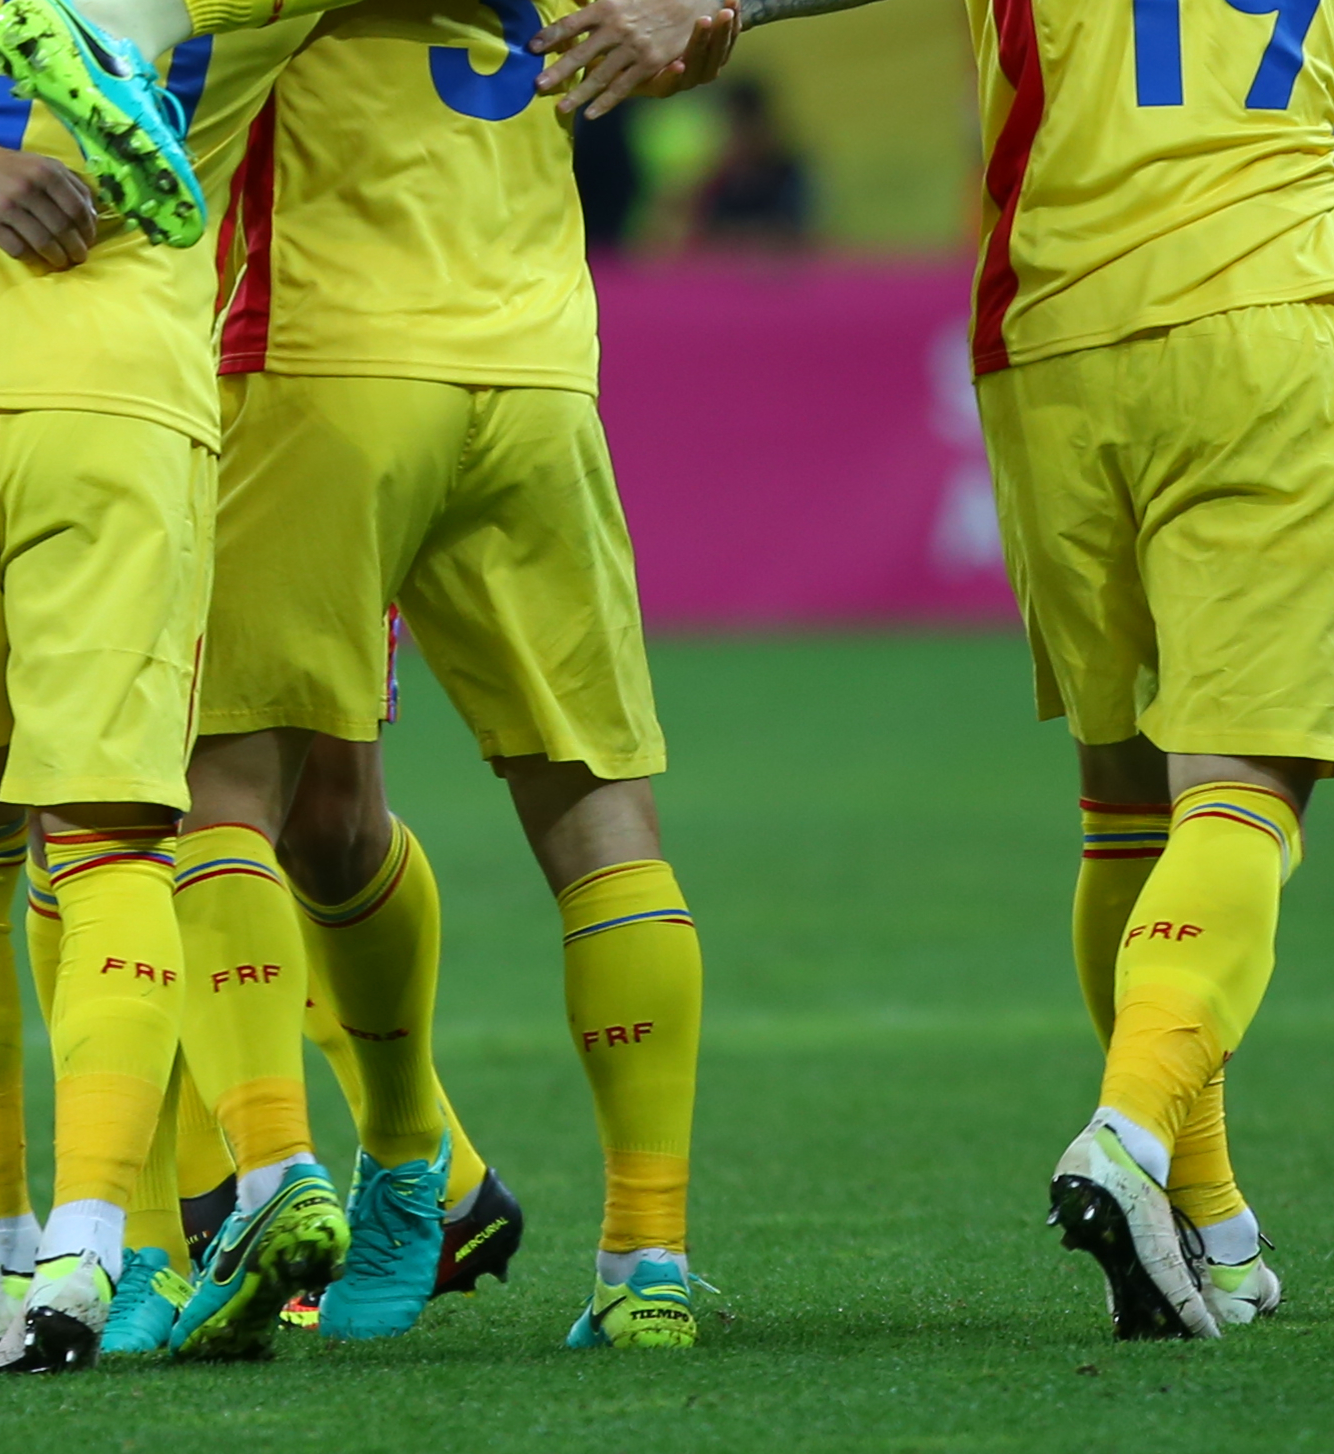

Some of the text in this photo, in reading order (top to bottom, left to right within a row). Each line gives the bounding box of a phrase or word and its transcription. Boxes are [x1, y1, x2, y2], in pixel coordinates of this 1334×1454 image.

[1125, 921, 1203, 948] FRF
[101, 957, 177, 986] FRF
[212, 964, 282, 992] FRF
[583, 1021, 654, 1052] FRF
[455, 1216, 509, 1263] MERCURIAL
[631, 1308, 690, 1323] TIEMPO
